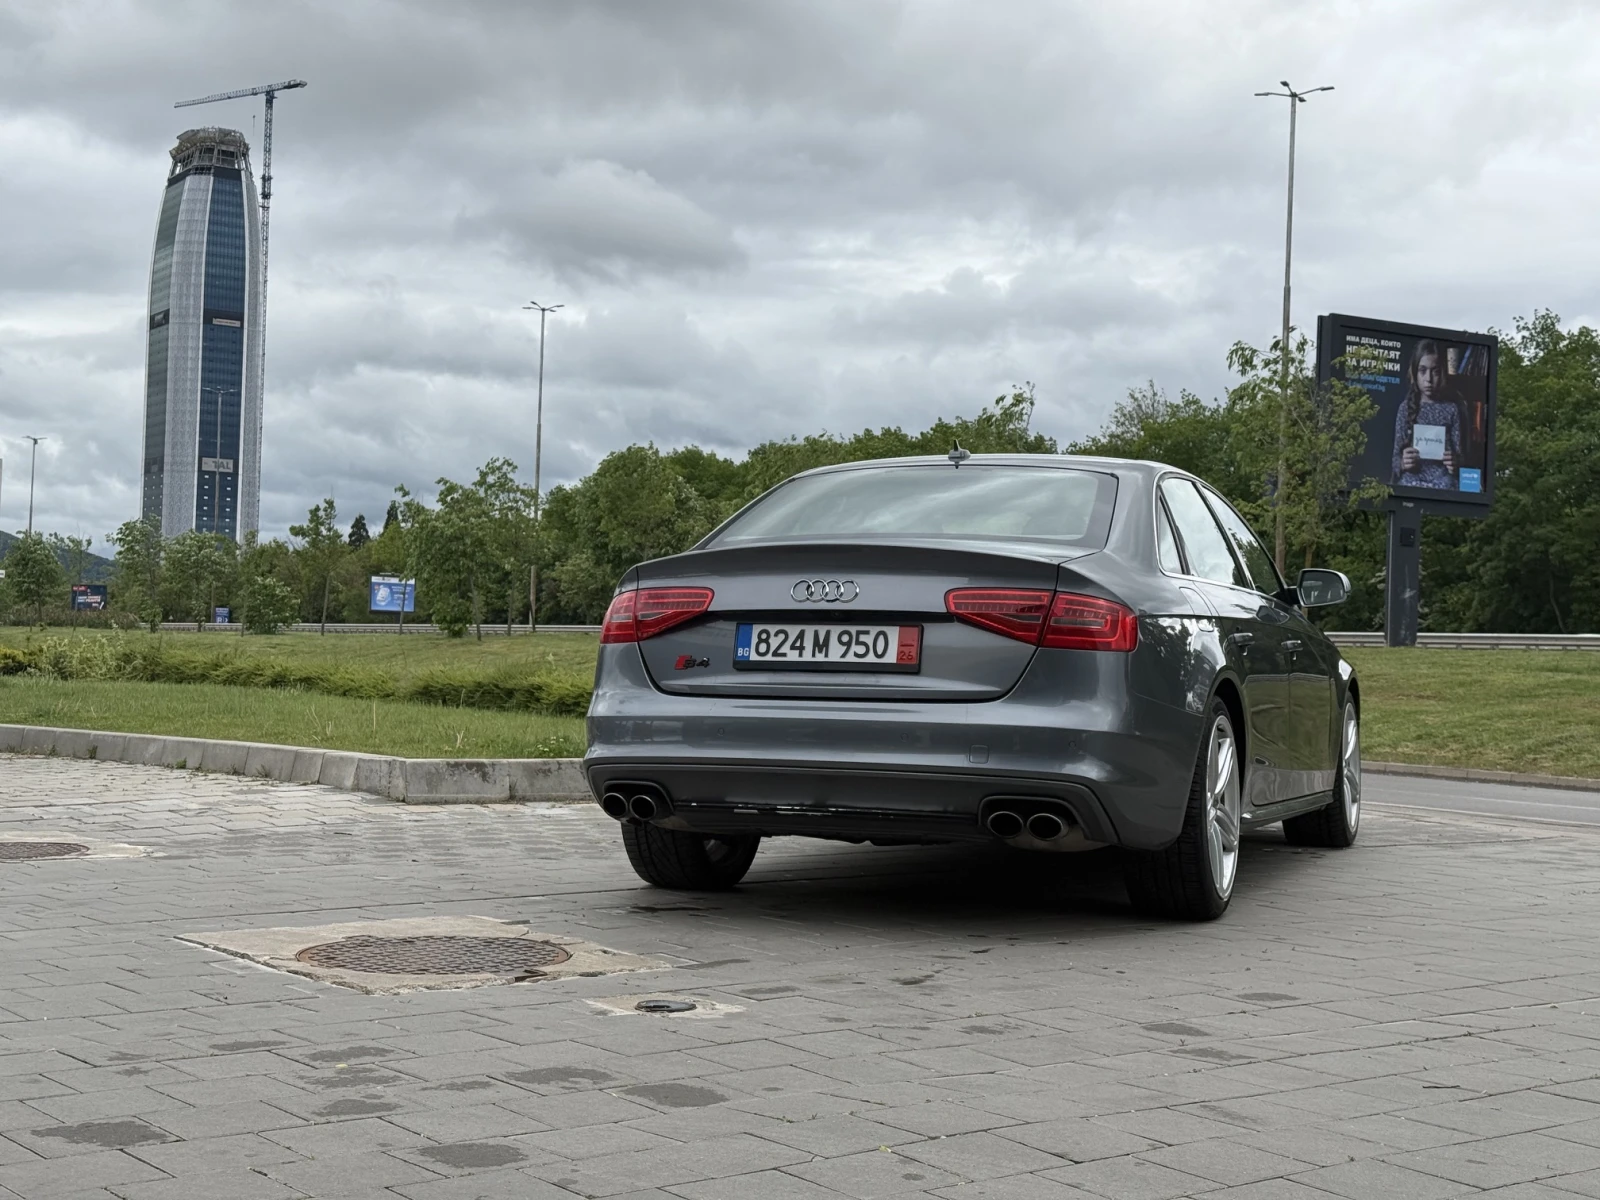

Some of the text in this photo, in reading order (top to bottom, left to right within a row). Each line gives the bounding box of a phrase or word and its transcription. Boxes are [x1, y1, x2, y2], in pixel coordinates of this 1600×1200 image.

[1346, 335, 1401, 348] ИМА ДЕЦА, КОИТО
[754, 628, 890, 660] 824 M 950
[737, 647, 750, 657] BG
[899, 651, 914, 661] 26
